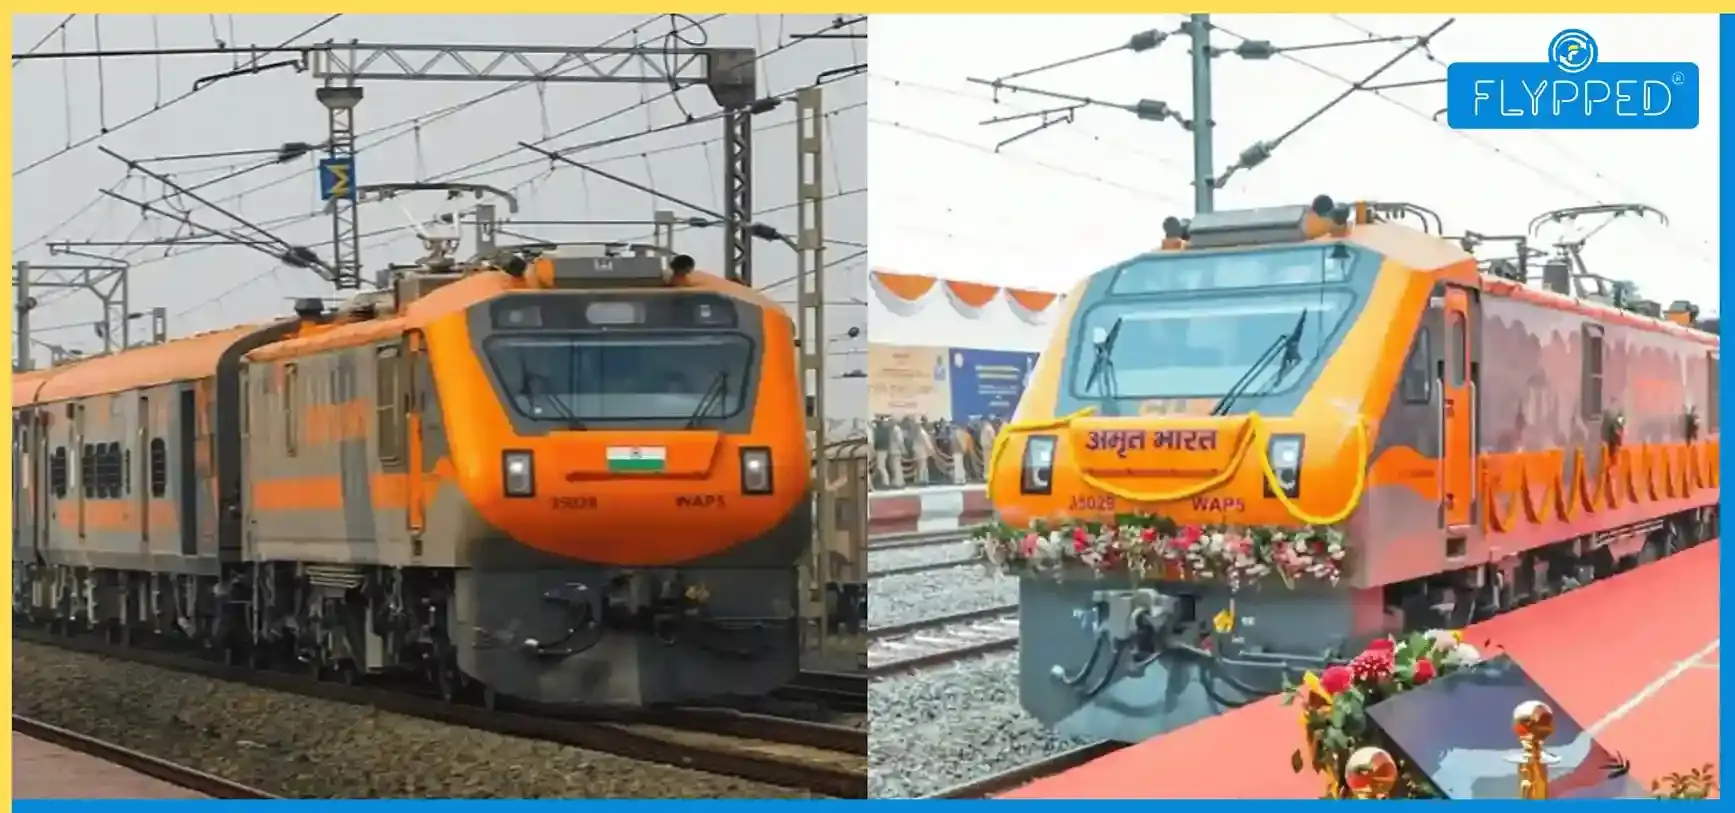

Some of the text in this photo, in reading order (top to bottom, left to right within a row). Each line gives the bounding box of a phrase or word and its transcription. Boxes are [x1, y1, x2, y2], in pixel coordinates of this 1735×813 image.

[1085, 430, 1218, 458] अमृत भारत
[1191, 496, 1246, 513] WAP5
